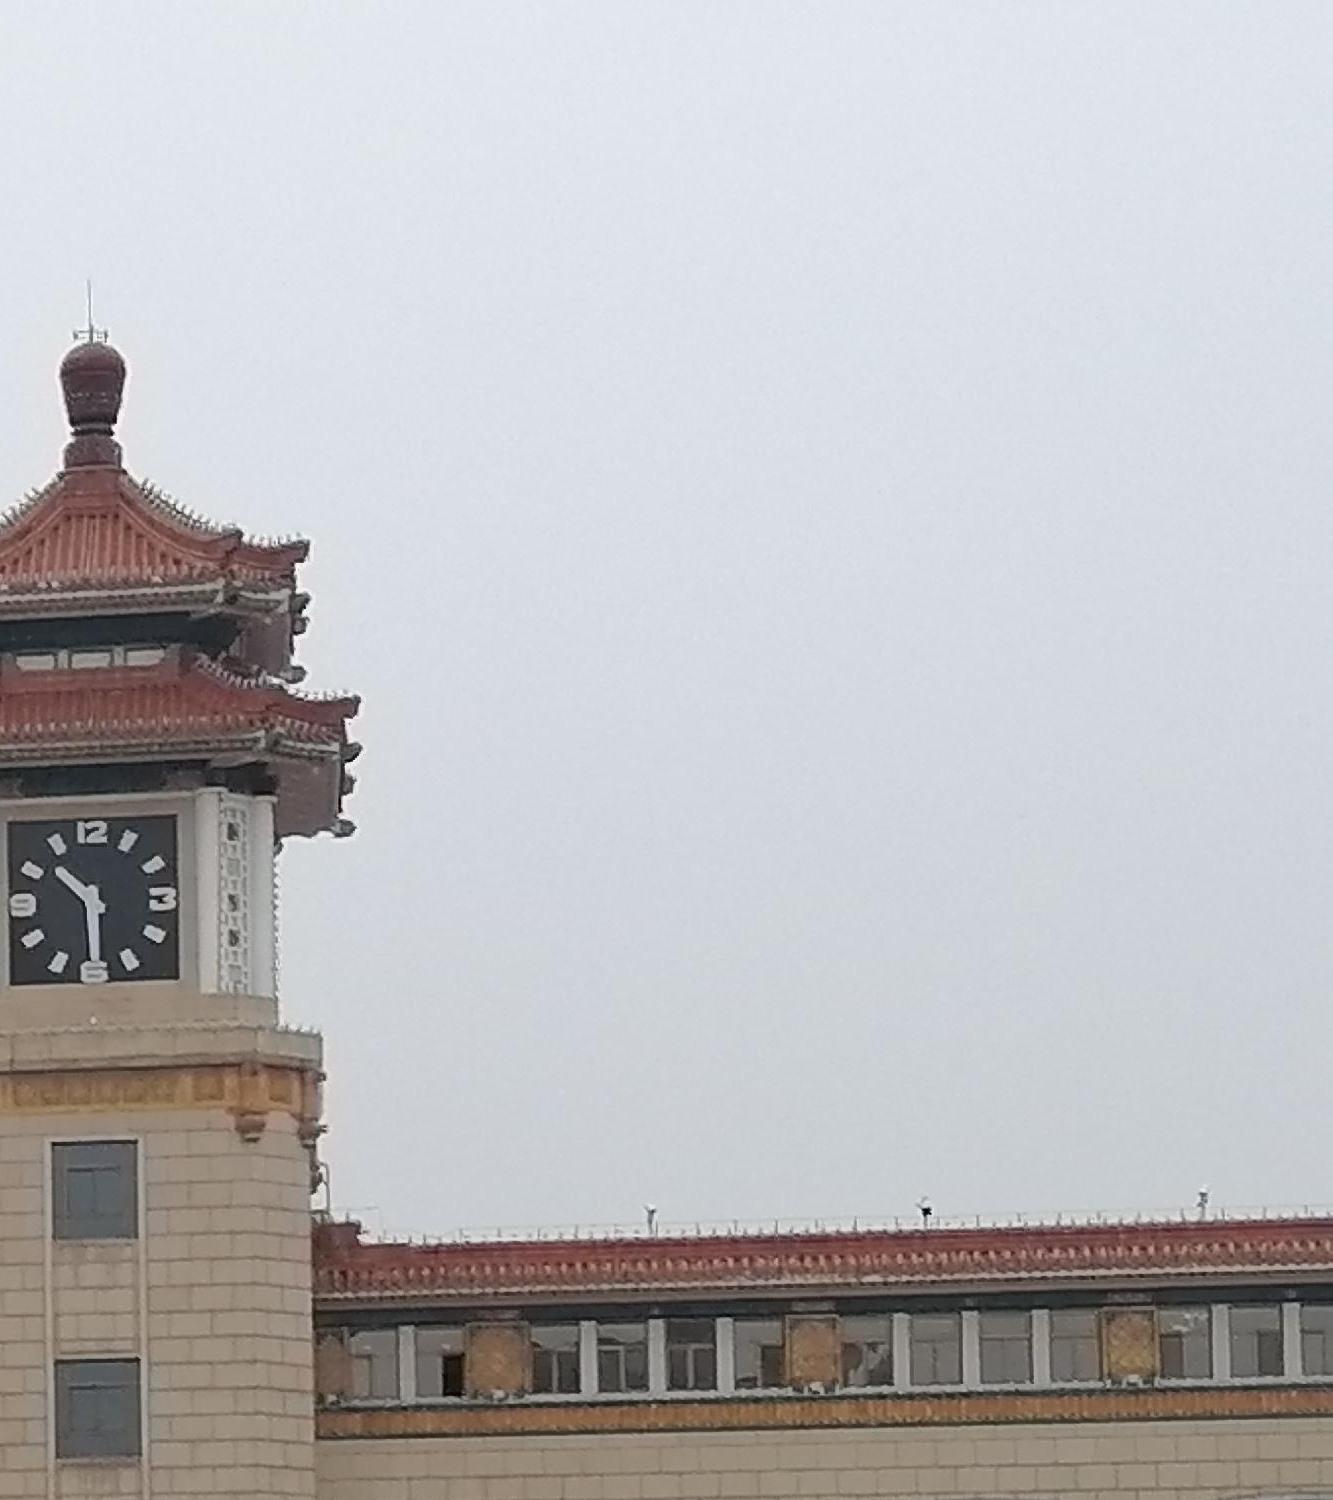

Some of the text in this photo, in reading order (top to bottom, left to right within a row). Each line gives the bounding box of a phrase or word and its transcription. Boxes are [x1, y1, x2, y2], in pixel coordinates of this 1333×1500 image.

[77, 820, 108, 844] 12
[10, 893, 37, 917] 9
[149, 887, 177, 911] 3
[80, 960, 109, 983] 6
